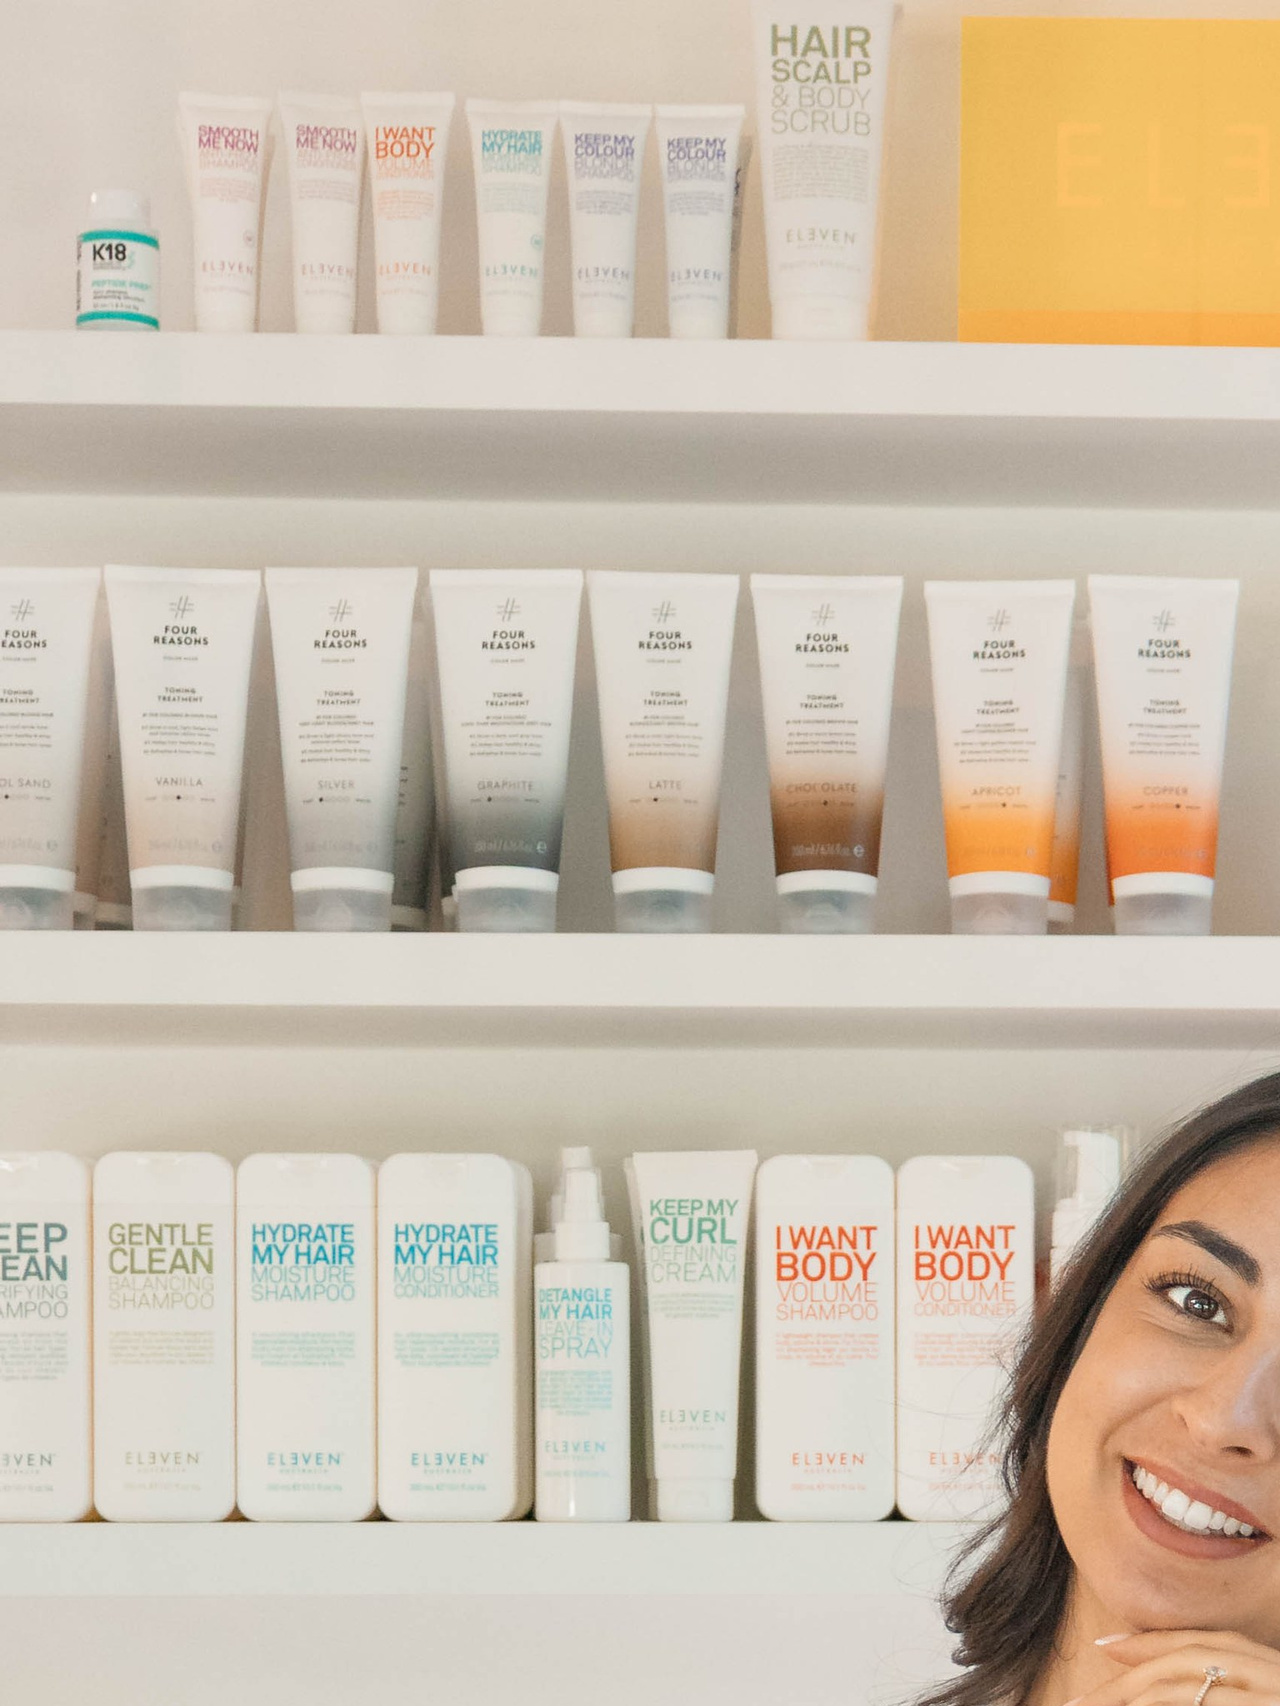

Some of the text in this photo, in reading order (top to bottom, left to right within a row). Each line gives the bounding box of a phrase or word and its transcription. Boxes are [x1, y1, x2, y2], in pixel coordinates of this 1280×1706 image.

[771, 22, 872, 59] HAIR
[771, 58, 872, 84] SCALP
[771, 85, 872, 110] & BODY
[772, 109, 872, 136] SCRUB
[198, 125, 259, 142] SMOOTH
[296, 125, 357, 141] SMOOTH
[376, 126, 436, 141] I WANT
[482, 130, 542, 142] HYDRATE
[574, 133, 635, 148] KEEP MY
[198, 136, 259, 154] ME NOW
[296, 136, 356, 153] ME NOW
[376, 140, 435, 159] BODY
[482, 141, 542, 156] MY HAIR
[667, 138, 727, 150] KEEP MY
[574, 145, 635, 160] COLOUR
[668, 149, 726, 162] COLOUR
[93, 243, 128, 262] K18
[4, 630, 37, 640] FOUR
[164, 625, 197, 635] FOUR
[325, 629, 357, 638] FOUR
[492, 630, 525, 639] FOUR
[649, 630, 681, 640] FOUR
[806, 633, 838, 642] FOUR
[0, 640, 47, 650] EASONS
[153, 635, 208, 646] REASONS
[314, 639, 367, 649] REASONS
[481, 639, 535, 651] REASONS
[638, 640, 692, 651] REASONS
[795, 643, 849, 654] REASONS
[983, 640, 1016, 650] FOUR
[1148, 639, 1180, 649] FOUR
[972, 650, 1026, 660] REASONS
[1137, 649, 1191, 660] REASONS
[18, 777, 52, 790] SAND
[155, 777, 203, 787] VANILLA
[318, 780, 354, 790] SILVER
[478, 780, 533, 792] GRAPHITE
[649, 780, 681, 791] LATTE
[786, 784, 857, 793] CHOCOLATE
[971, 786, 1021, 796] APRICOT
[1143, 786, 1189, 796] COPPER
[650, 1199, 739, 1216] KEEP MY
[108, 1223, 213, 1250] GENTLE
[251, 1223, 355, 1245] HYDRATE
[394, 1223, 499, 1245] HYDRATE
[650, 1217, 738, 1246] CURL
[776, 1225, 879, 1251] I WANT
[914, 1224, 1016, 1251] I WANT
[251, 1245, 355, 1265] MY HAIR
[394, 1245, 498, 1265] MY HAIR
[650, 1244, 737, 1263] DEFINING
[0, 1255, 68, 1281] EAN
[108, 1251, 213, 1275] CLEAN
[775, 1250, 877, 1282] BODY
[914, 1250, 1016, 1282] BODY
[251, 1265, 355, 1284] MOISTURE
[394, 1265, 499, 1284] MOISTURE
[651, 1262, 738, 1284] CREAM
[109, 1275, 214, 1293] BALANCING
[394, 1283, 499, 1299] CONDITIONER
[776, 1281, 879, 1303] VOLUME
[914, 1281, 1017, 1302] VOLUME
[251, 1283, 355, 1302] SHAMPOO
[539, 1287, 612, 1303] DETANGLE
[109, 1292, 214, 1311] SHAMPOO
[914, 1302, 1018, 1317] CONDITIONER
[540, 1303, 612, 1320] MY HAIR
[776, 1303, 879, 1322] SHAMPOO
[539, 1337, 612, 1360] SPRAY
